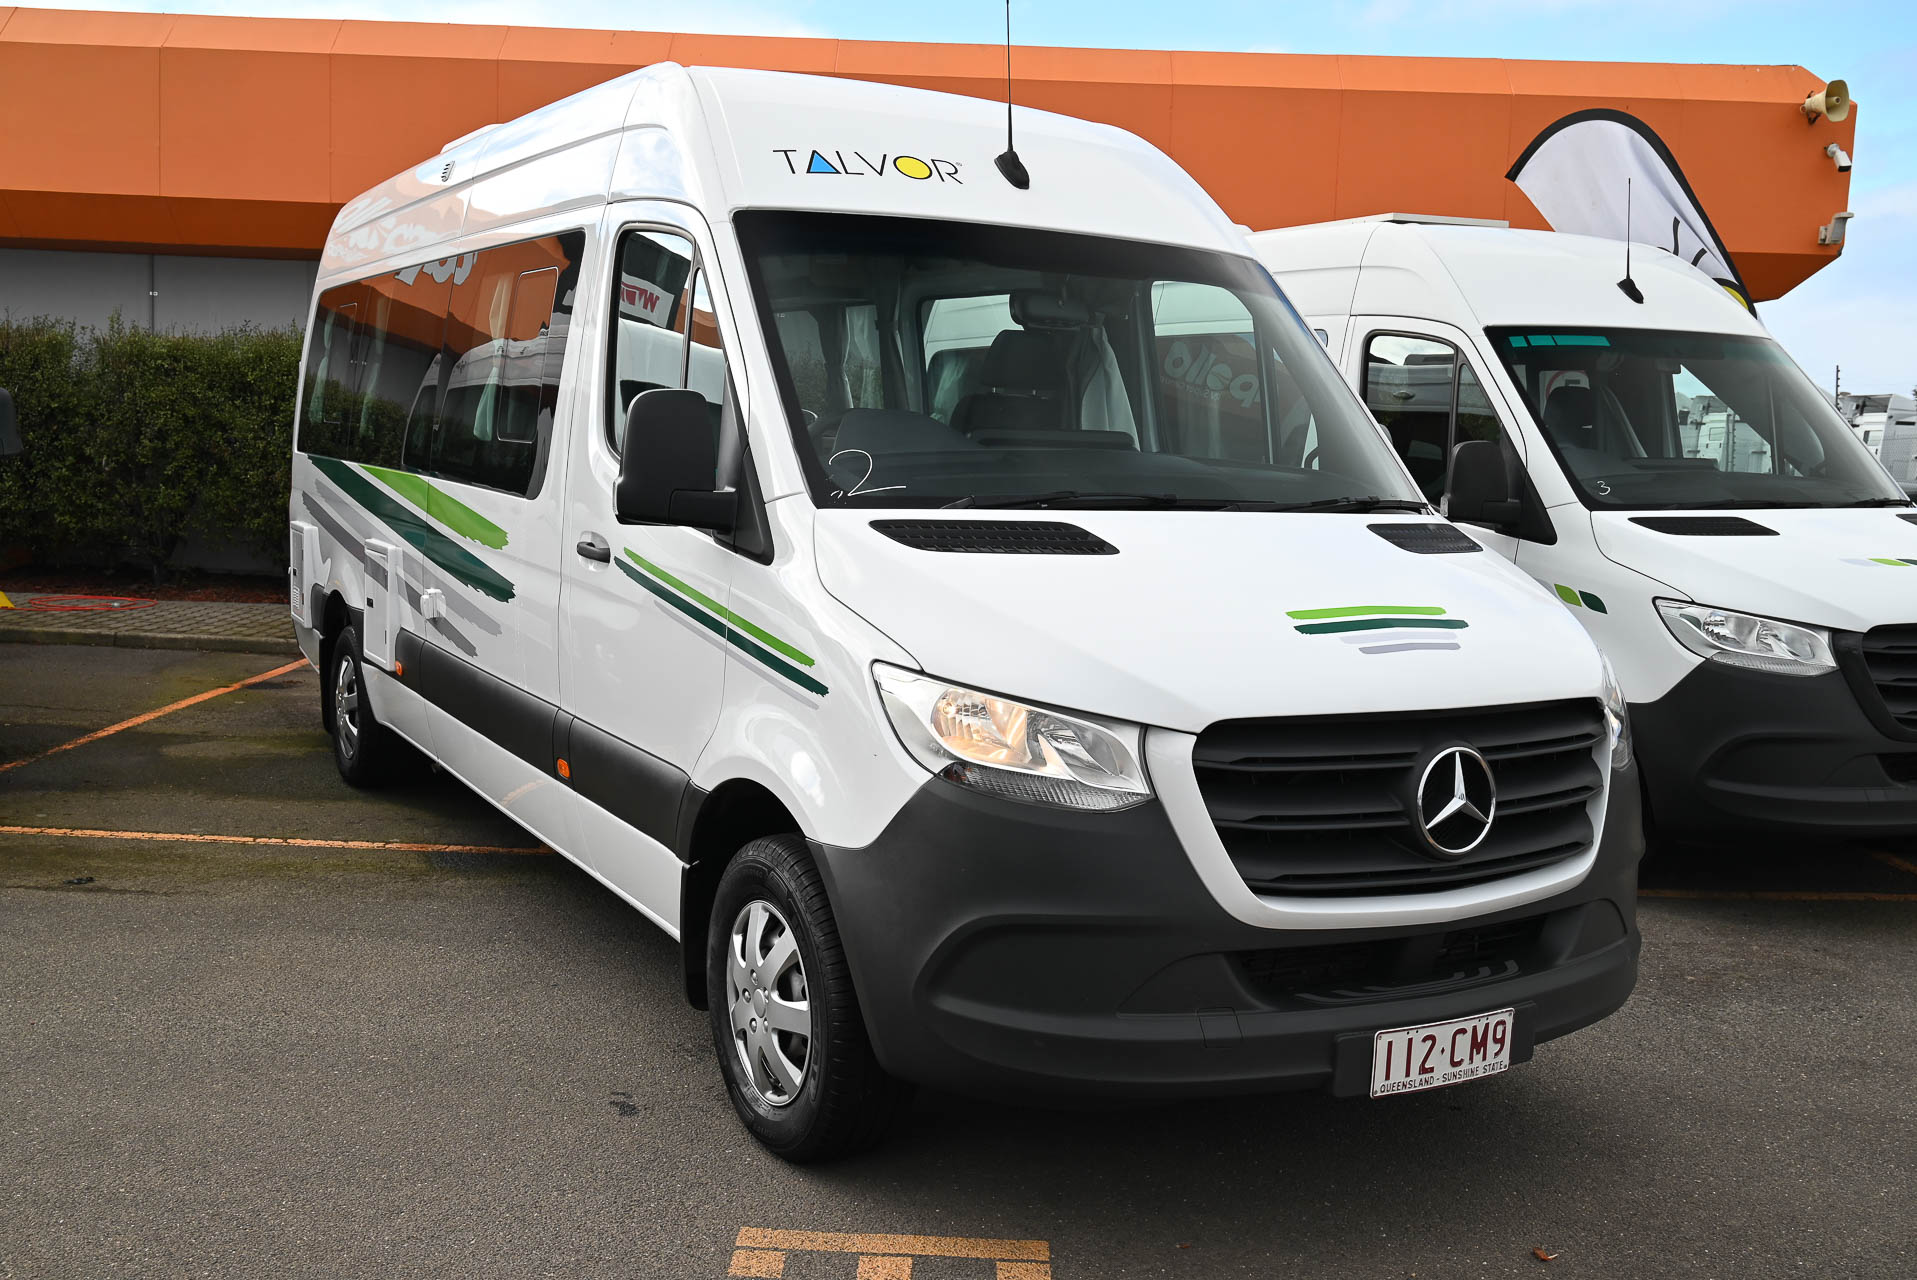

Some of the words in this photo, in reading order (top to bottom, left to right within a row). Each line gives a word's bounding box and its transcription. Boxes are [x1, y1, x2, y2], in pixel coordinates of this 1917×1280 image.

[773, 150, 963, 184] TALVOR
[828, 449, 906, 496] 2
[1597, 480, 1611, 496] 3
[1379, 1075, 1434, 1094] QUEENSLAND
[1442, 1066, 1480, 1083] SUNSHINE
[1482, 1060, 1504, 1074] STATE
